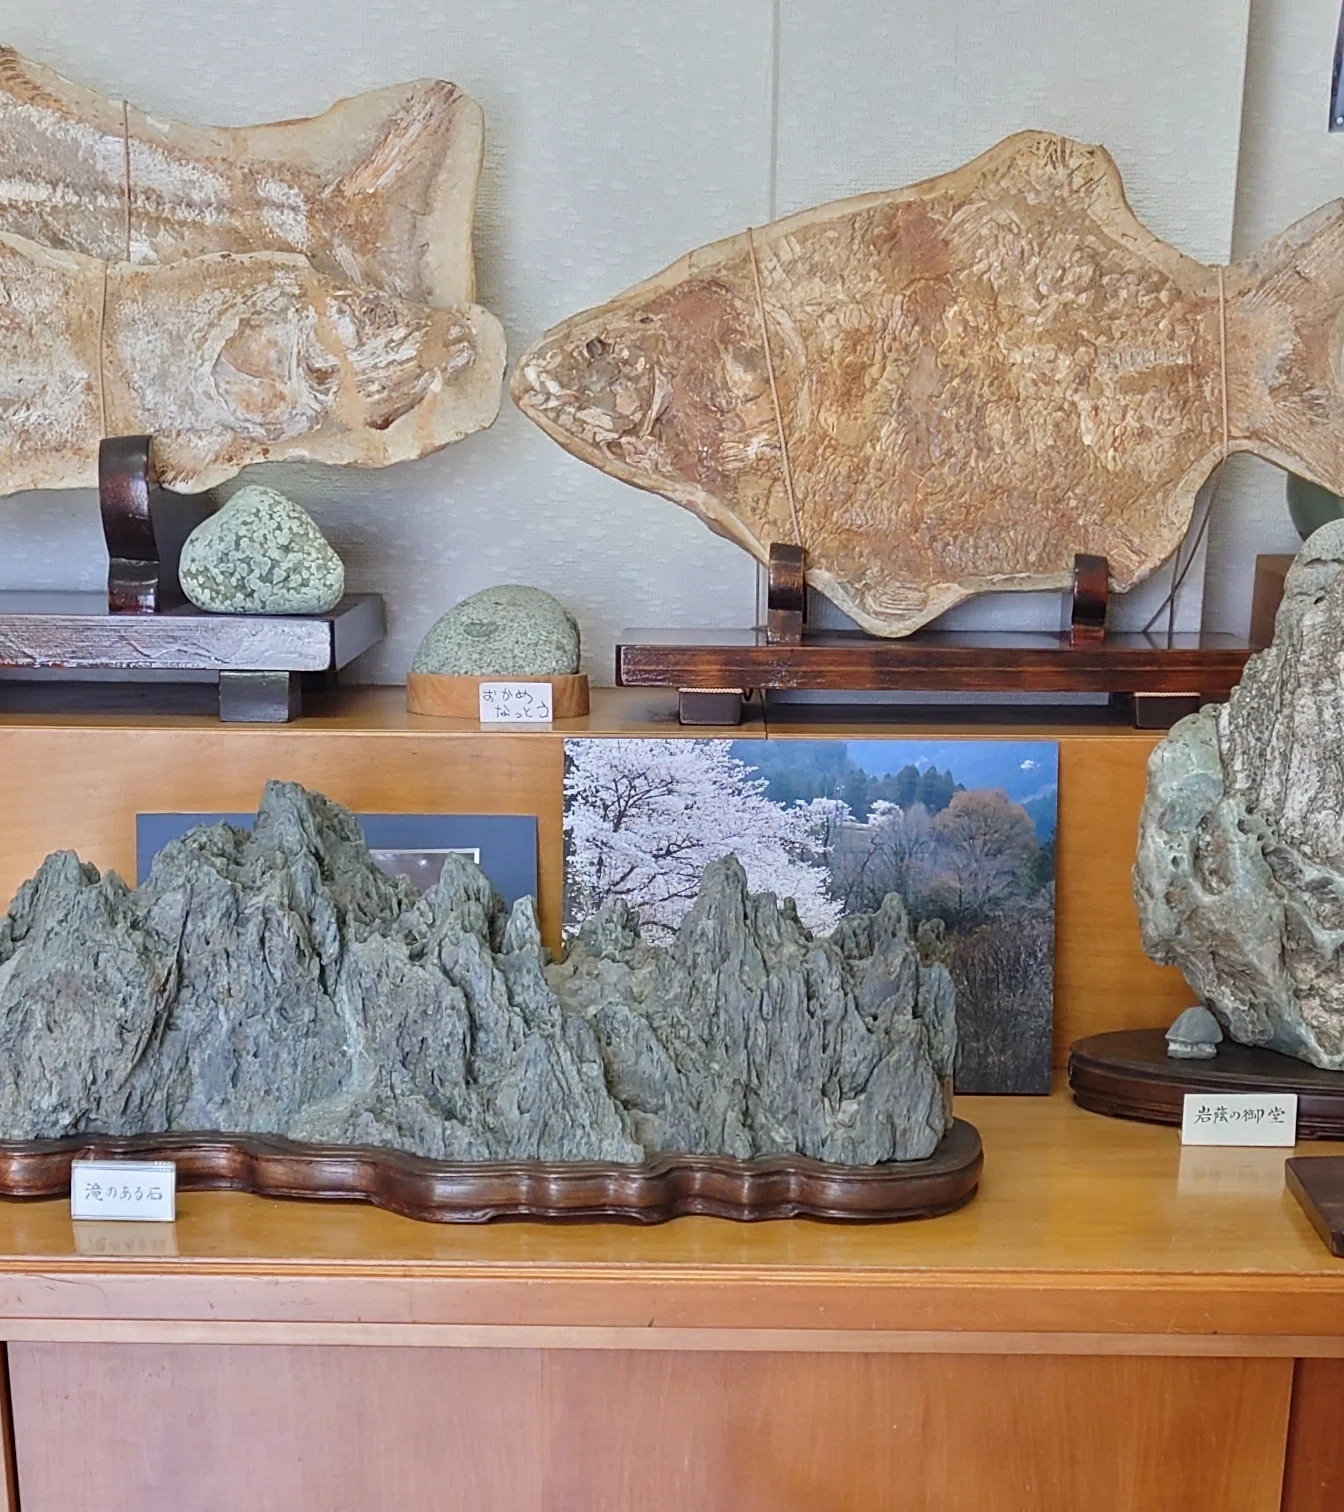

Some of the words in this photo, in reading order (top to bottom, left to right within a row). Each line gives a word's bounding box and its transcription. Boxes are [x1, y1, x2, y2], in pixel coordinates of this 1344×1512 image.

[483, 688, 533, 704] おかめ
[85, 1182, 163, 1202] 滝のある石
